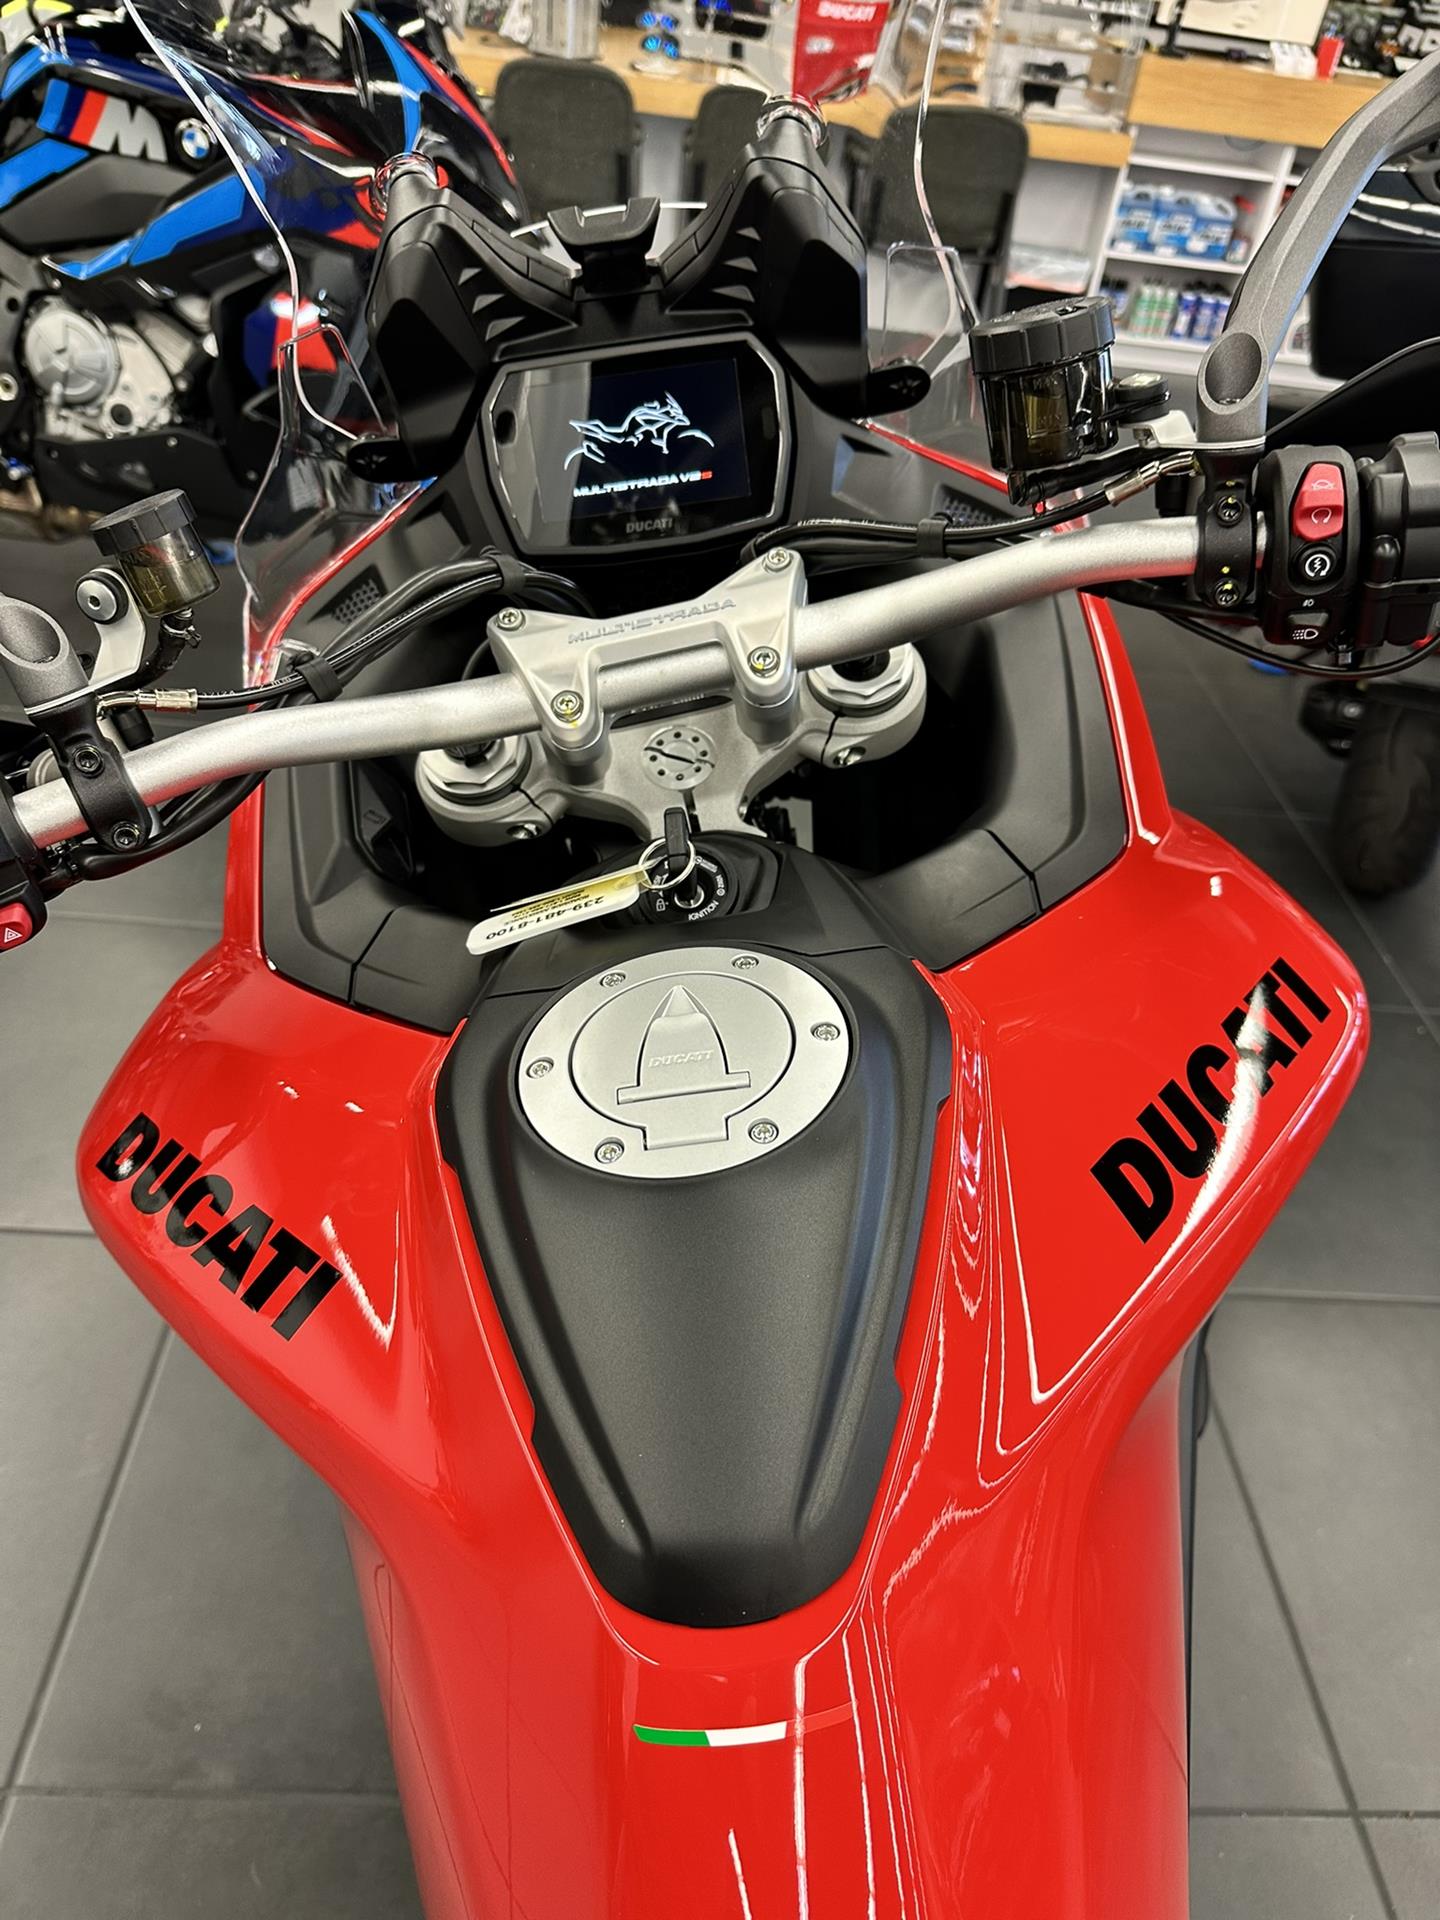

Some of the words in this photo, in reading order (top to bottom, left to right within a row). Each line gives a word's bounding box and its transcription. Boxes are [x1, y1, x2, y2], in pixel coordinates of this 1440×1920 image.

[88, 96, 168, 163] M
[573, 473, 680, 498] MULTISTRADA
[626, 517, 673, 534] DUCATI
[568, 598, 737, 645] MULTISTRADA
[688, 900, 719, 921] IGNITION
[648, 1049, 714, 1068] DUCATI
[1090, 957, 1331, 1244] DUCATI
[96, 1112, 343, 1341] DUCATI
